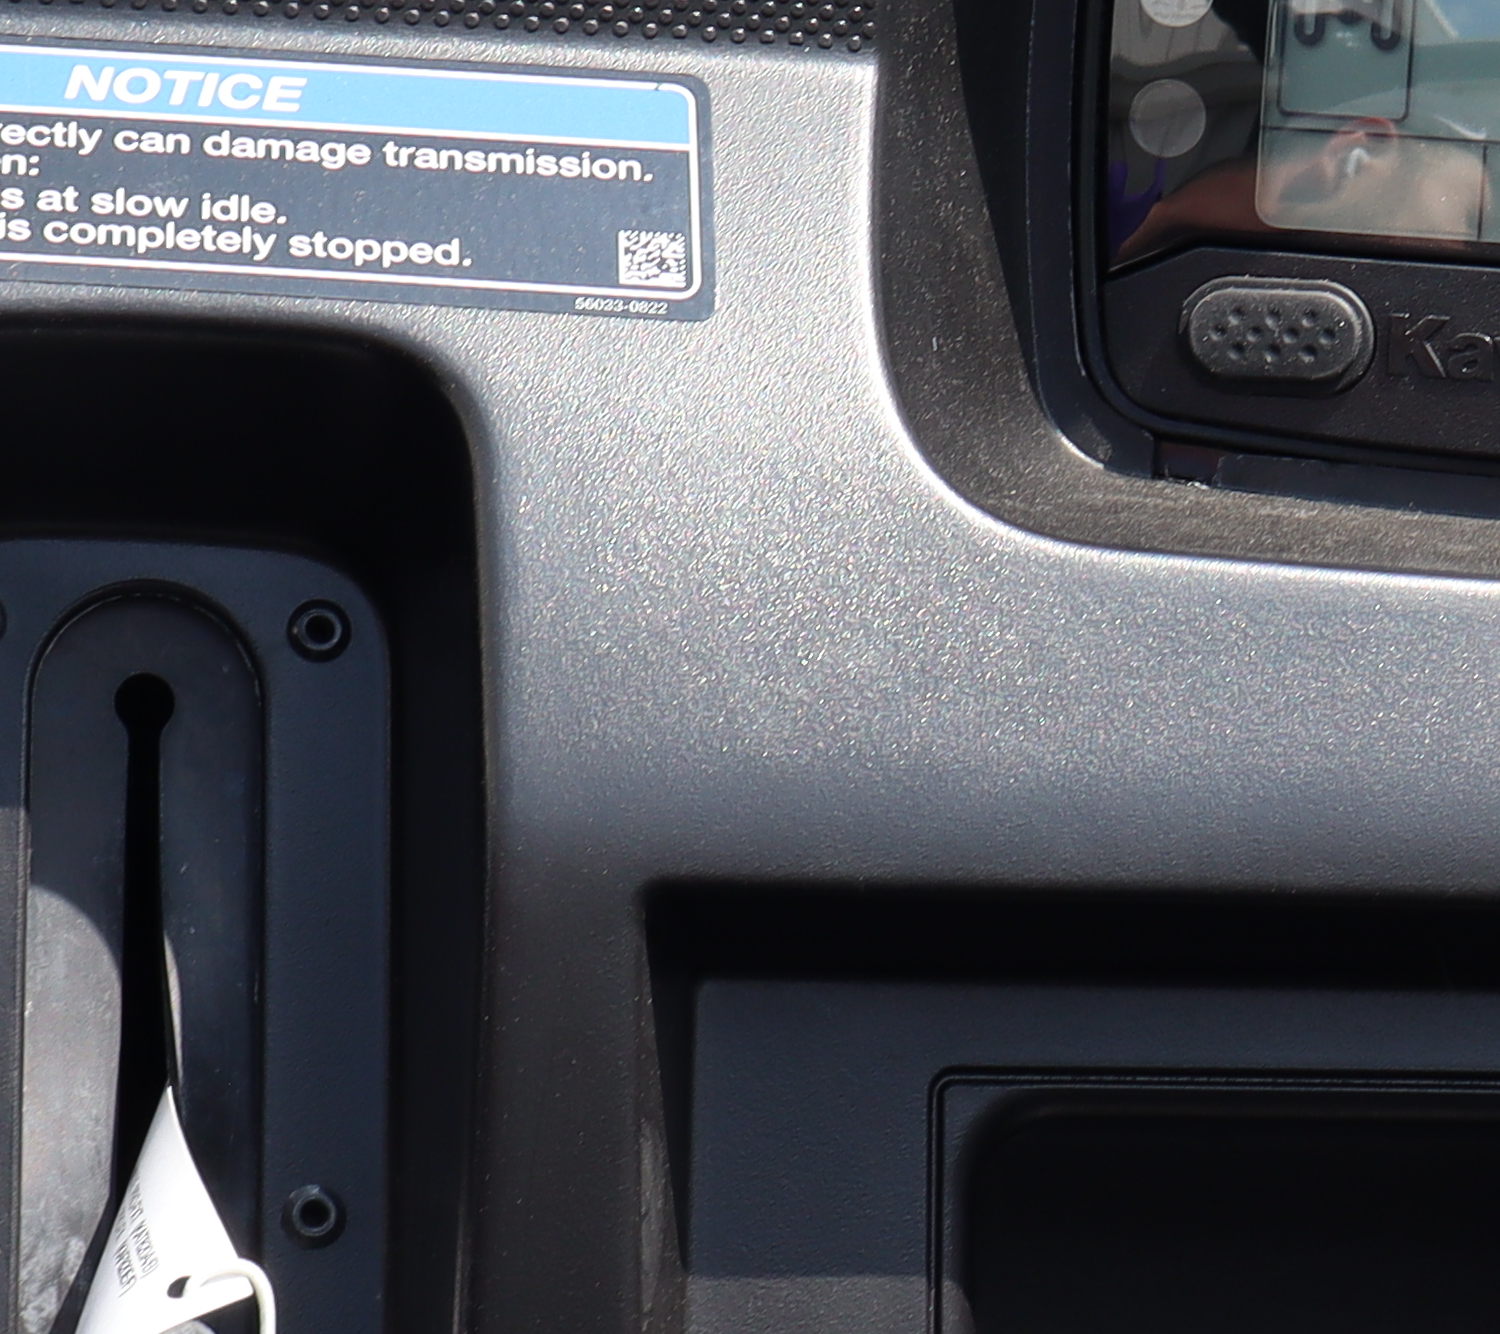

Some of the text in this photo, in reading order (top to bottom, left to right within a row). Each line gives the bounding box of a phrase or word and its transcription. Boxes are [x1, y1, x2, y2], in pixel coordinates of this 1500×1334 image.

[64, 63, 307, 113] NOTICE
[113, 126, 194, 157] can
[202, 126, 372, 170] damage
[383, 140, 654, 183] transmission.
[36, 182, 79, 212] at
[91, 182, 189, 219] slow
[200, 188, 288, 224] idle.
[43, 214, 278, 262] completely
[289, 226, 473, 268] stopped.
